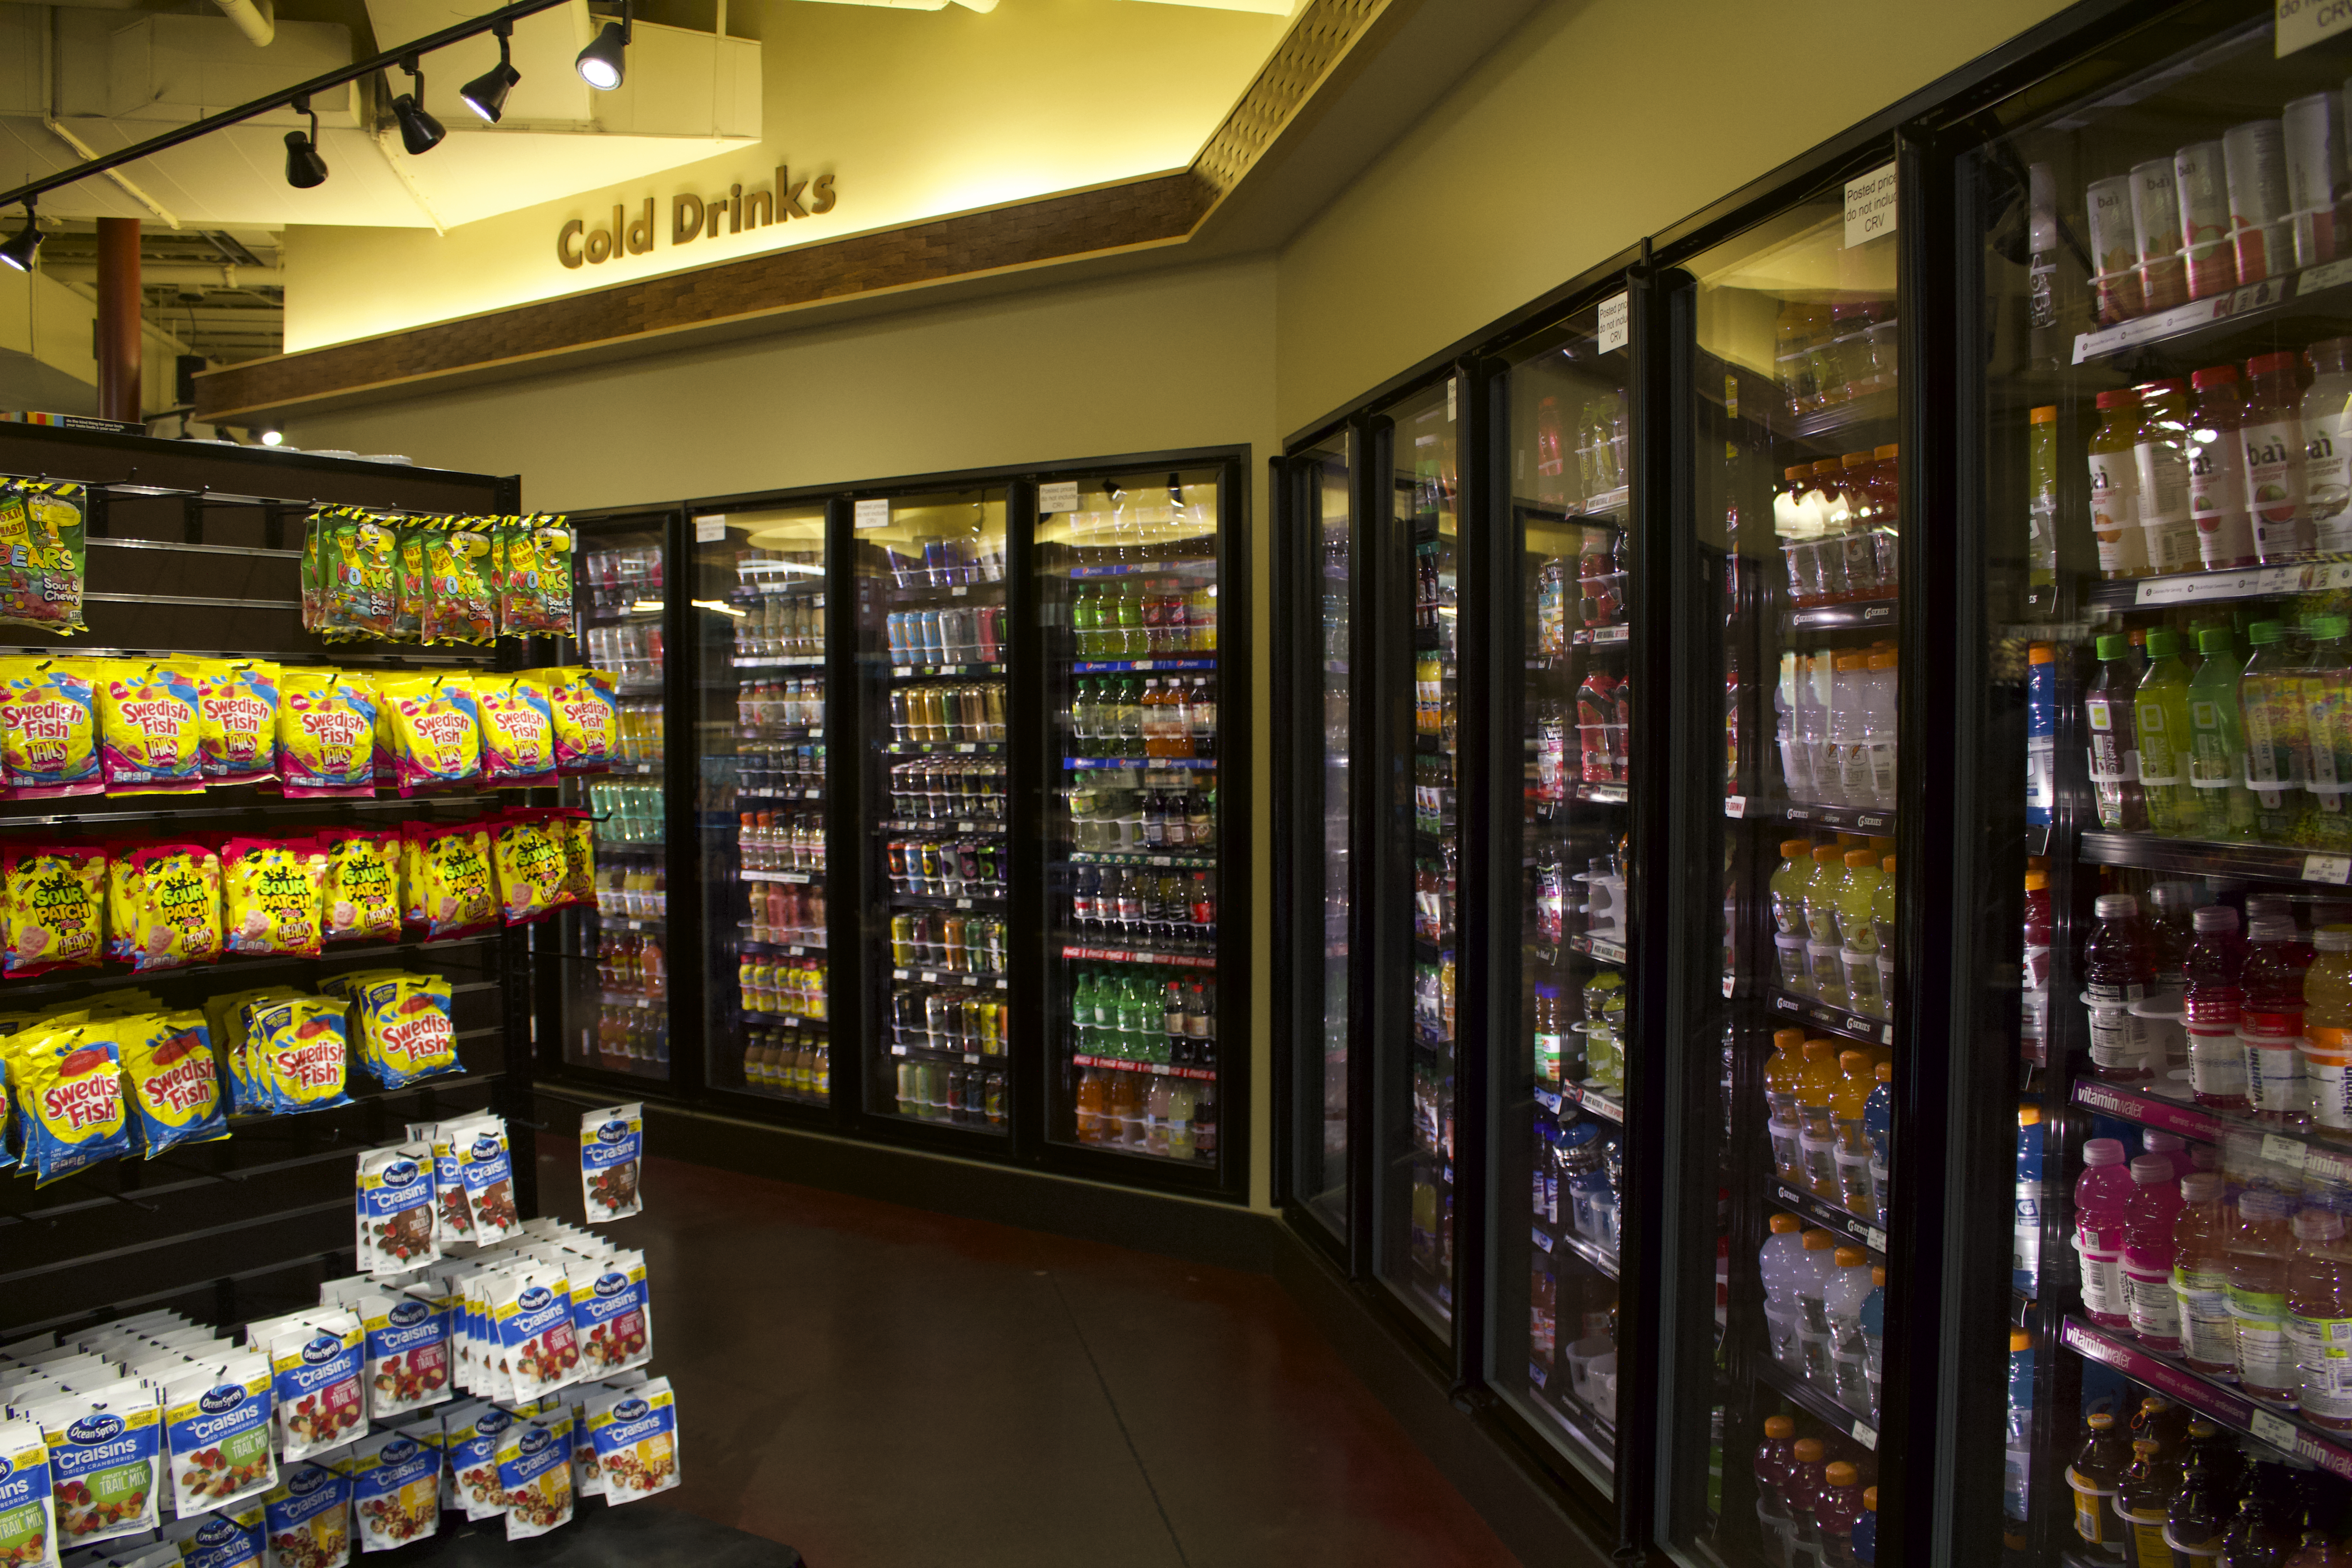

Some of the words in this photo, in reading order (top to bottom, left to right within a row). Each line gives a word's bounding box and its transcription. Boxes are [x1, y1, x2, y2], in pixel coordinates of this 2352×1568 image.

[1847, 180, 1875, 204] Posted
[557, 197, 654, 269] Cold
[671, 165, 835, 246] Drinks
[1847, 208, 1856, 222] do
[1859, 200, 1872, 217] not
[1865, 212, 1885, 233] CRV
[1600, 303, 1617, 319] Posted
[1599, 323, 1606, 333] do
[1610, 329, 1622, 343] CRV
[0, 544, 76, 571] BEARS
[43, 577, 69, 590] Sour
[71, 580, 78, 591] &
[431, 575, 485, 595] WORMS
[509, 570, 568, 590] WORMS
[44, 590, 80, 605] Chewy
[1865, 607, 1872, 620] G
[1871, 608, 1889, 617] SERIES
[113, 686, 127, 695] NEW!
[1, 701, 83, 728] Swedish
[121, 701, 189, 725] Swedish
[203, 699, 269, 720] Swedish
[564, 701, 608, 720] Swedish
[22, 720, 68, 740] Fish
[141, 717, 178, 736] Fish
[220, 713, 258, 732] Fish
[302, 712, 365, 734] Swedish
[414, 712, 469, 736] Swedish
[495, 711, 544, 730] Swedish
[578, 715, 604, 730] Fish
[225, 734, 256, 752] TAILS
[318, 727, 354, 745] Fish
[431, 730, 461, 745] Fish
[509, 725, 539, 740] Fish
[26, 740, 67, 763] TAILS
[145, 738, 178, 758] TAILS
[320, 747, 350, 765] TAILS
[1787, 808, 1793, 820] G
[1793, 810, 1809, 819] SERIES
[1857, 815, 1865, 828] G
[1864, 818, 1882, 827] SERIES
[19, 859, 34, 871] NEW!
[516, 844, 555, 866] SOUR
[344, 866, 387, 884] SOUR
[444, 858, 481, 880] SOUR
[519, 853, 561, 882] PATCH
[259, 879, 307, 895] SOUR
[344, 882, 391, 901] PATCH
[446, 870, 488, 895] PATCH
[35, 886, 83, 906] SOUR
[162, 884, 204, 906] SOUR
[260, 893, 311, 911] PATCH
[36, 904, 89, 926] PATCH
[163, 901, 209, 926] PATCH
[184, 917, 202, 928] Kids
[281, 909, 301, 918] Kids
[365, 905, 395, 928] HEADS
[60, 919, 81, 930] Kids
[278, 921, 312, 942] HEADS
[59, 930, 93, 955] HEADS
[182, 927, 213, 953] HEADS
[1777, 997, 1783, 1009] G
[1782, 1000, 1798, 1011] SERIES
[1846, 1017, 1853, 1029] G
[1852, 1020, 1870, 1033] SERIES
[407, 1034, 450, 1062] Fish
[277, 1041, 345, 1078] Swedish
[145, 1058, 216, 1104] Swedish
[298, 1063, 338, 1089] Fish
[167, 1081, 210, 1113] Fish
[2078, 1086, 2145, 1118] vitaminwater
[65, 1098, 117, 1130] Fish
[591, 1140, 635, 1162] Craisins
[377, 1183, 427, 1208] Craisins
[1778, 1186, 1784, 1198] G
[1784, 1191, 1799, 1204] SERIES
[1847, 1219, 1854, 1232] G
[591, 1291, 638, 1317] Craisins
[519, 1303, 564, 1332] Craisins
[385, 1322, 440, 1348] Craisins
[304, 1349, 322, 1359] Ocean
[322, 1342, 339, 1358] Spray
[2066, 1327, 2132, 1369] vitaminwater
[299, 1356, 352, 1387] Craisins
[203, 1396, 222, 1409] Ocean
[223, 1391, 241, 1407] Spray
[71, 1426, 95, 1440] Ocean
[95, 1421, 119, 1440] Spray
[195, 1404, 259, 1440] Craisins
[201, 1434, 218, 1445] DRIED
[219, 1418, 258, 1437] CRANBERRIES
[612, 1416, 660, 1441] Craisins
[59, 1439, 137, 1470] Craisins
[232, 1441, 254, 1459] TRAIL
[2297, 1437, 2352, 1478] minwate
[64, 1465, 86, 1476] DRIED
[88, 1454, 135, 1470] CRANBERRIES
[518, 1446, 560, 1476] Craisins
[103, 1473, 122, 1481] FRUIT
[129, 1465, 142, 1475] NUT
[377, 1459, 426, 1486] Craisins
[100, 1478, 127, 1497] TRAIL
[129, 1472, 147, 1490] MIX
[24, 1506, 38, 1517] NUT
[287, 1487, 336, 1519] Craisins
[27, 1511, 44, 1529] MIX
[196, 1537, 251, 1568] Craisins
